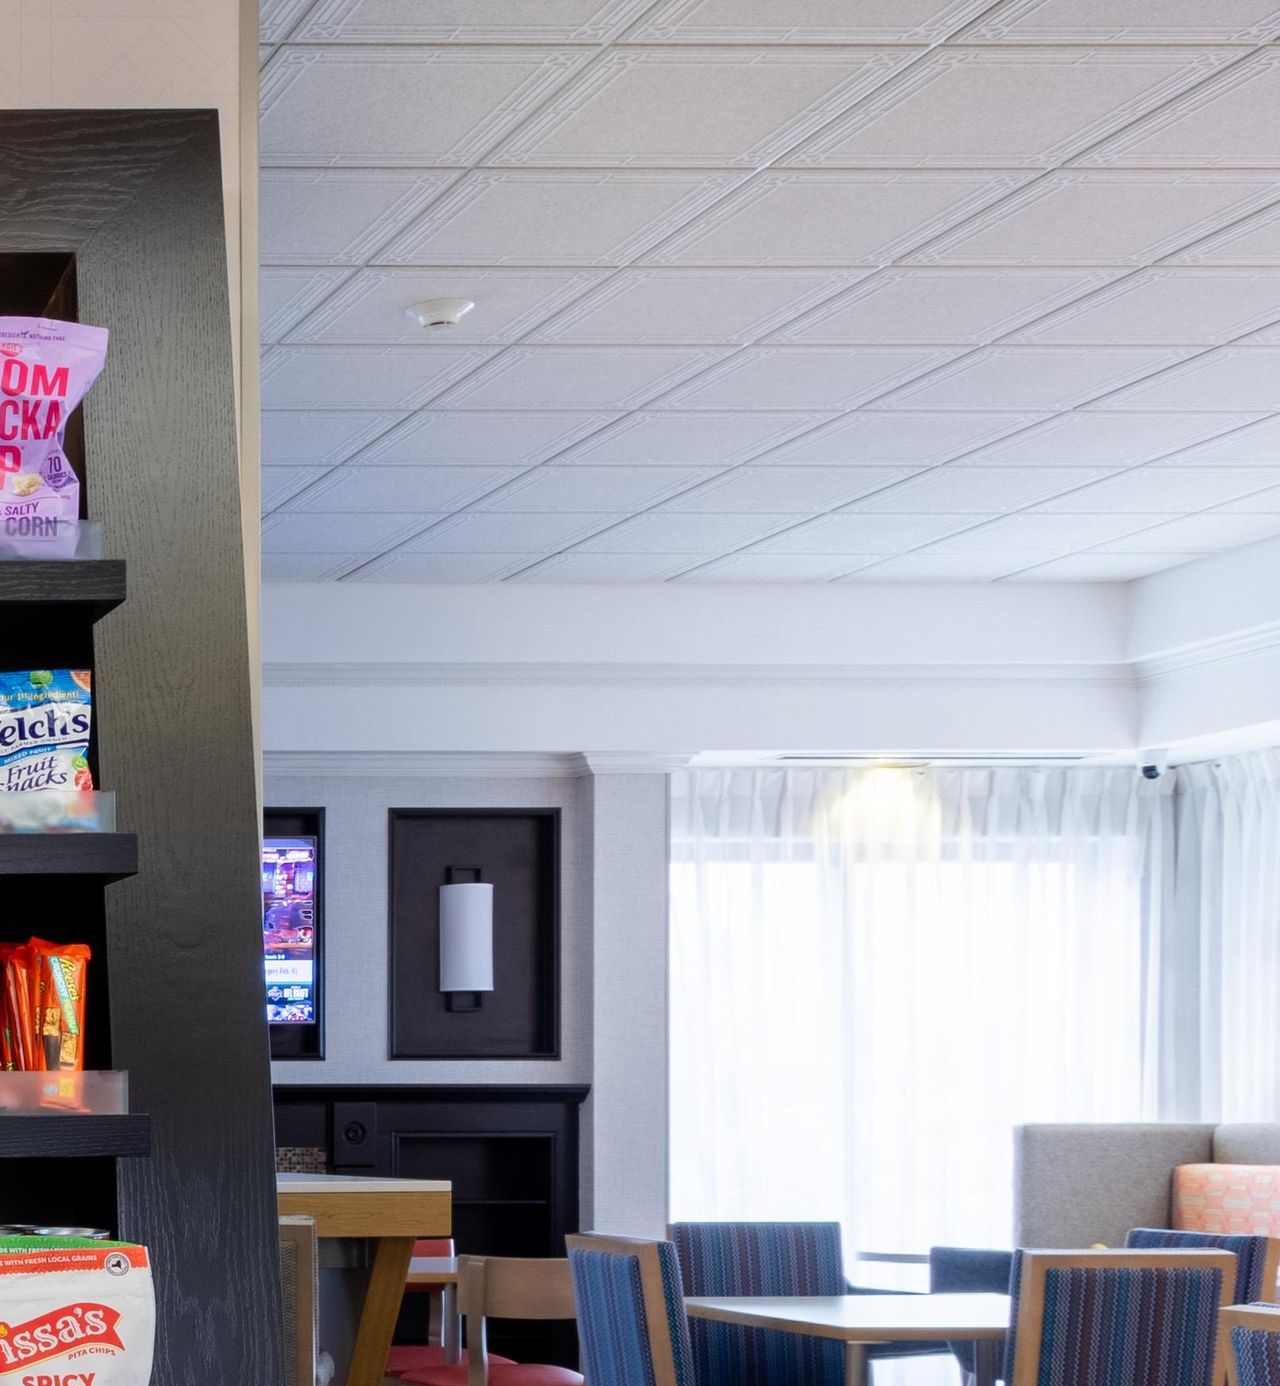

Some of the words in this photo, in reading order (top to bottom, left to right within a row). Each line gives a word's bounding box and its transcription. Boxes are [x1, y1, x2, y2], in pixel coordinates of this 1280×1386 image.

[7, 755, 60, 785] Fruit
[4, 1259, 25, 1267] WITH
[47, 1255, 71, 1264] LOCAL
[67, 1350, 89, 1361] PITA
[88, 1347, 117, 1357] CHIPS
